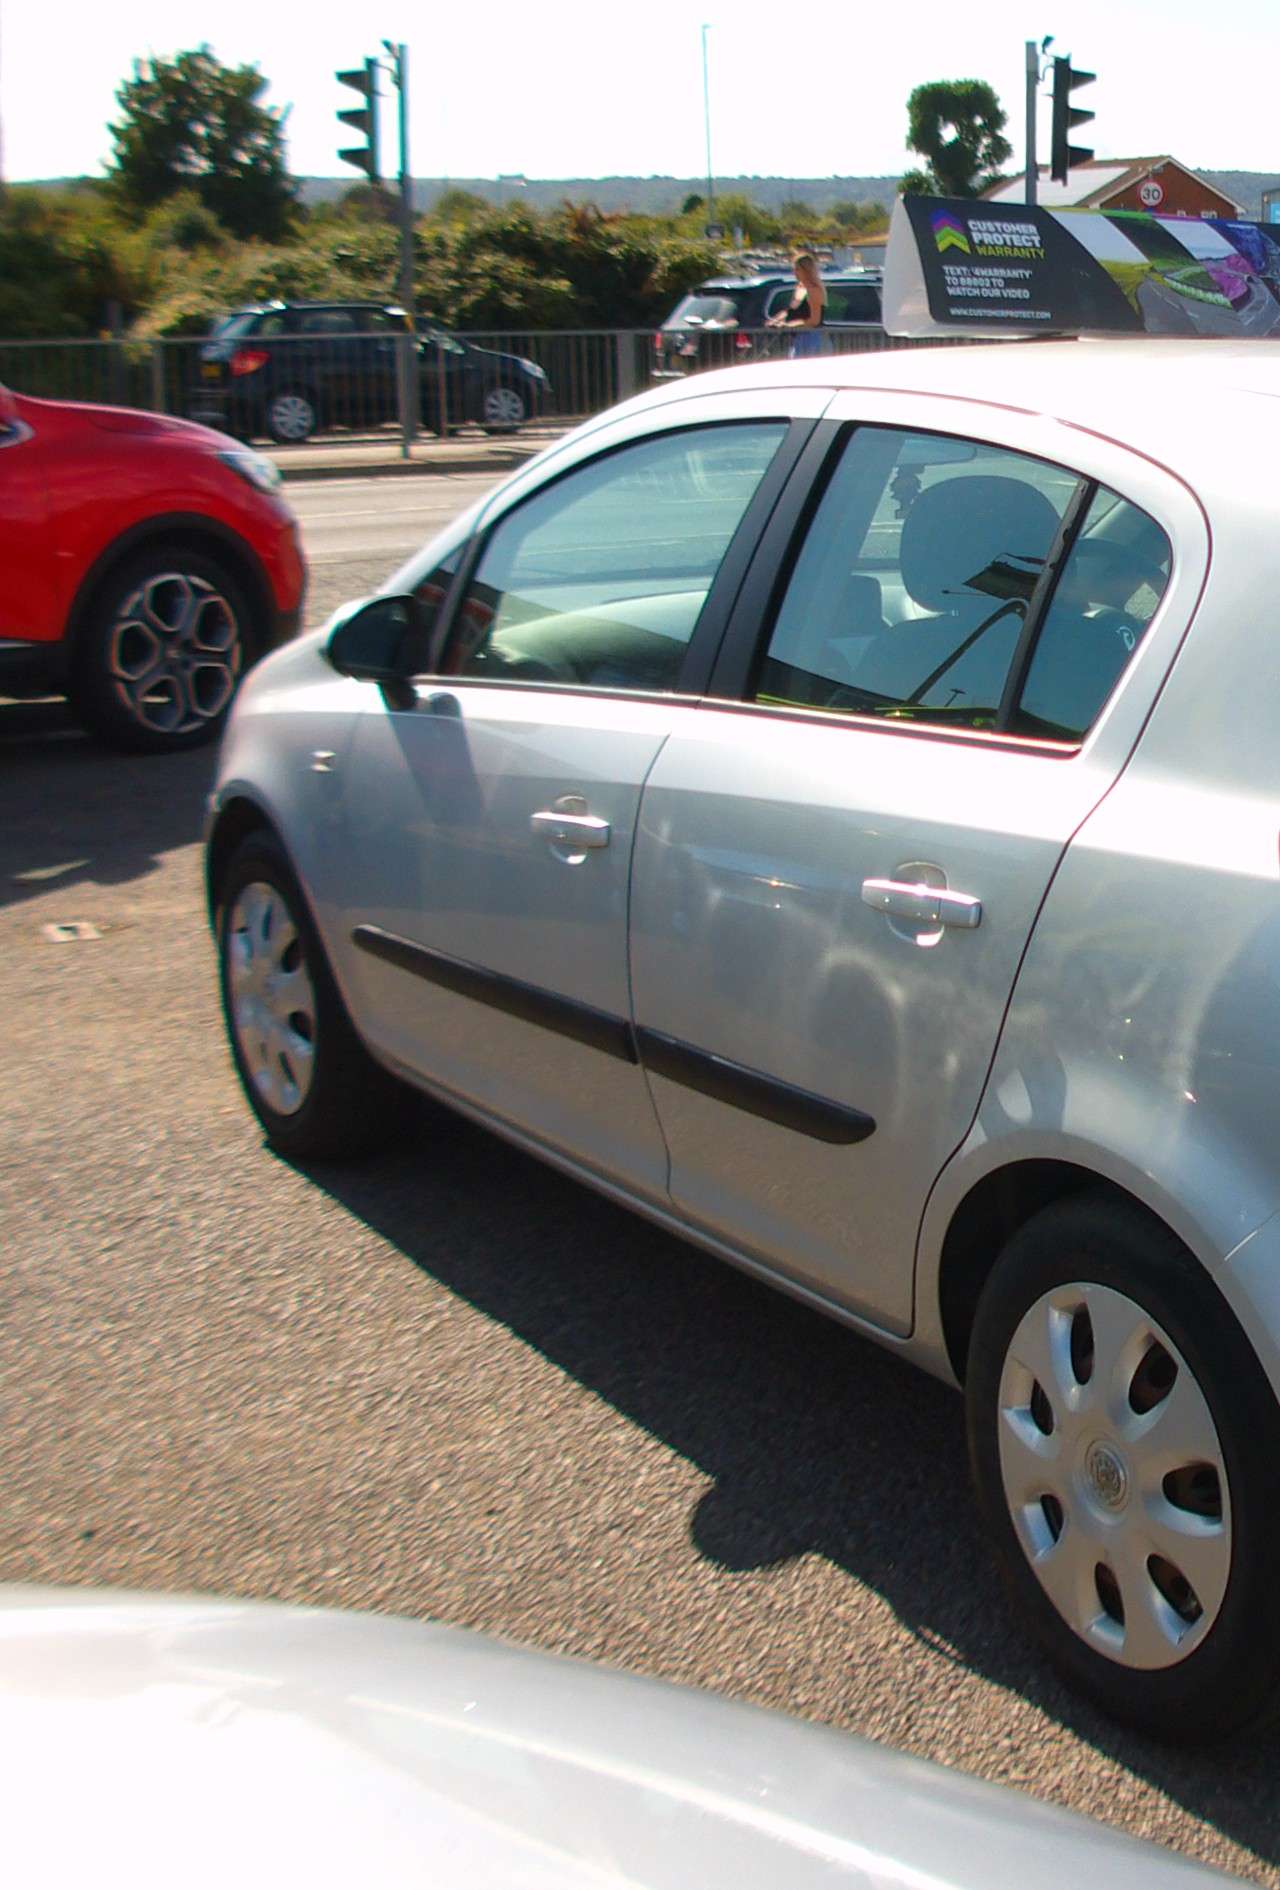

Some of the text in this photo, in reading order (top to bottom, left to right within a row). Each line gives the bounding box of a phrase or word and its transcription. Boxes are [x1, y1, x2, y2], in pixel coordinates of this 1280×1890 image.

[1142, 188, 1161, 200] 30
[968, 220, 1037, 234] CUSTOMER
[972, 232, 1040, 247] PROTECT
[976, 246, 1044, 258] WARRANTY
[946, 286, 1030, 300] WATCH OUR VIDEO
